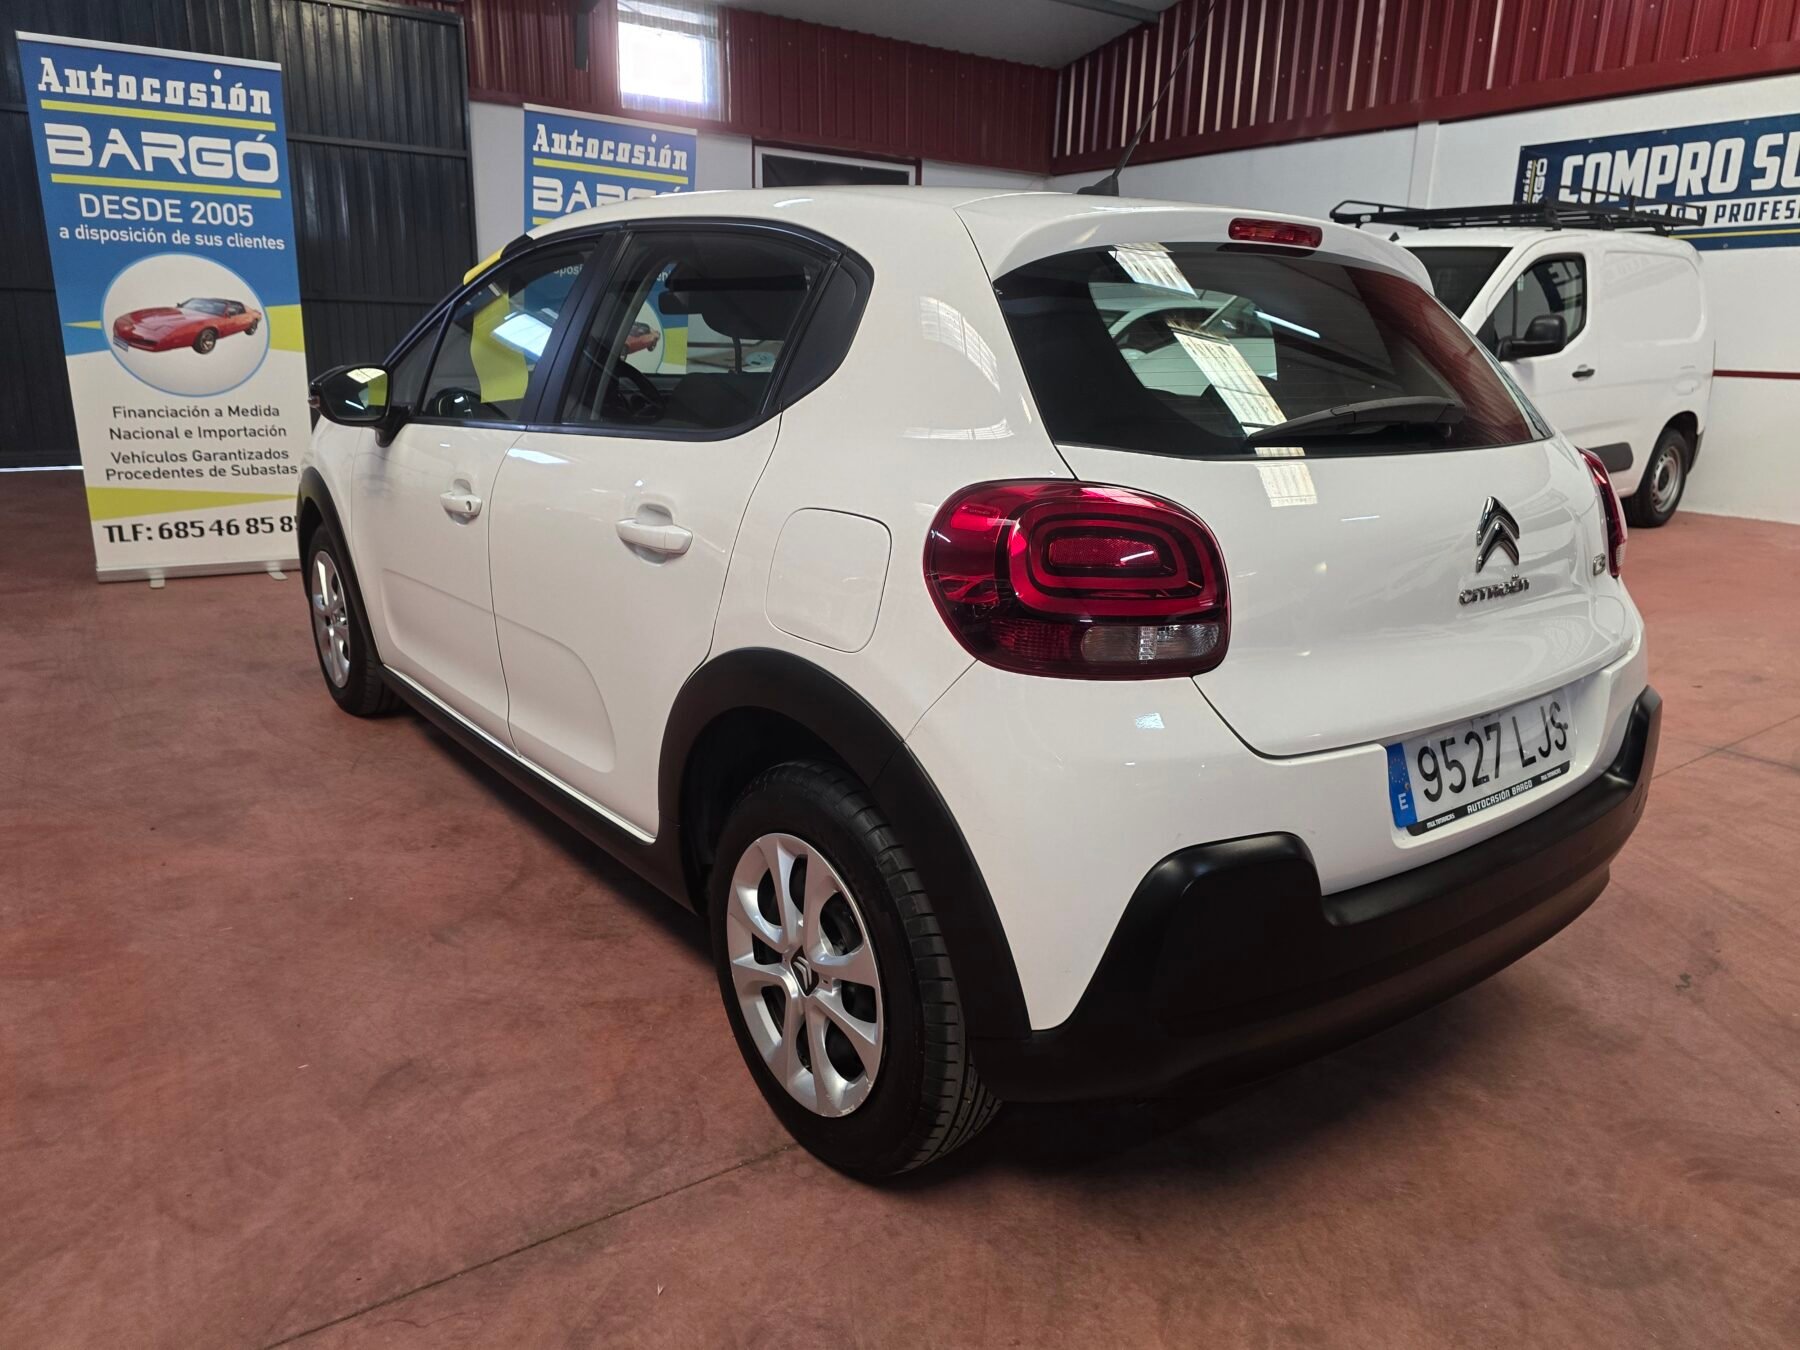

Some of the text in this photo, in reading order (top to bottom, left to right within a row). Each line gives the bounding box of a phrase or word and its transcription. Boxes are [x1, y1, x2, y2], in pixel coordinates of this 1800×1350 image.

[38, 57, 271, 115] Autocasión
[44, 122, 279, 183] BARGÓ
[533, 123, 687, 171] Autocasión
[1558, 137, 1745, 204] COMPRO
[533, 175, 681, 213] BAR
[79, 193, 254, 227] DESDE 2005
[1714, 199, 1800, 224] PROFES
[59, 224, 285, 250] a disposición de sus clientes
[112, 404, 280, 419] Financiación a Medida
[109, 425, 287, 441] Nacional e Importación
[111, 448, 289, 464] Vehículos Garantizados
[106, 463, 298, 481] Procedentes de Subastas
[103, 515, 298, 543] TLF: 685 46 85 8
[1417, 701, 1568, 802] 9527 LJS
[1398, 792, 1409, 811] E
